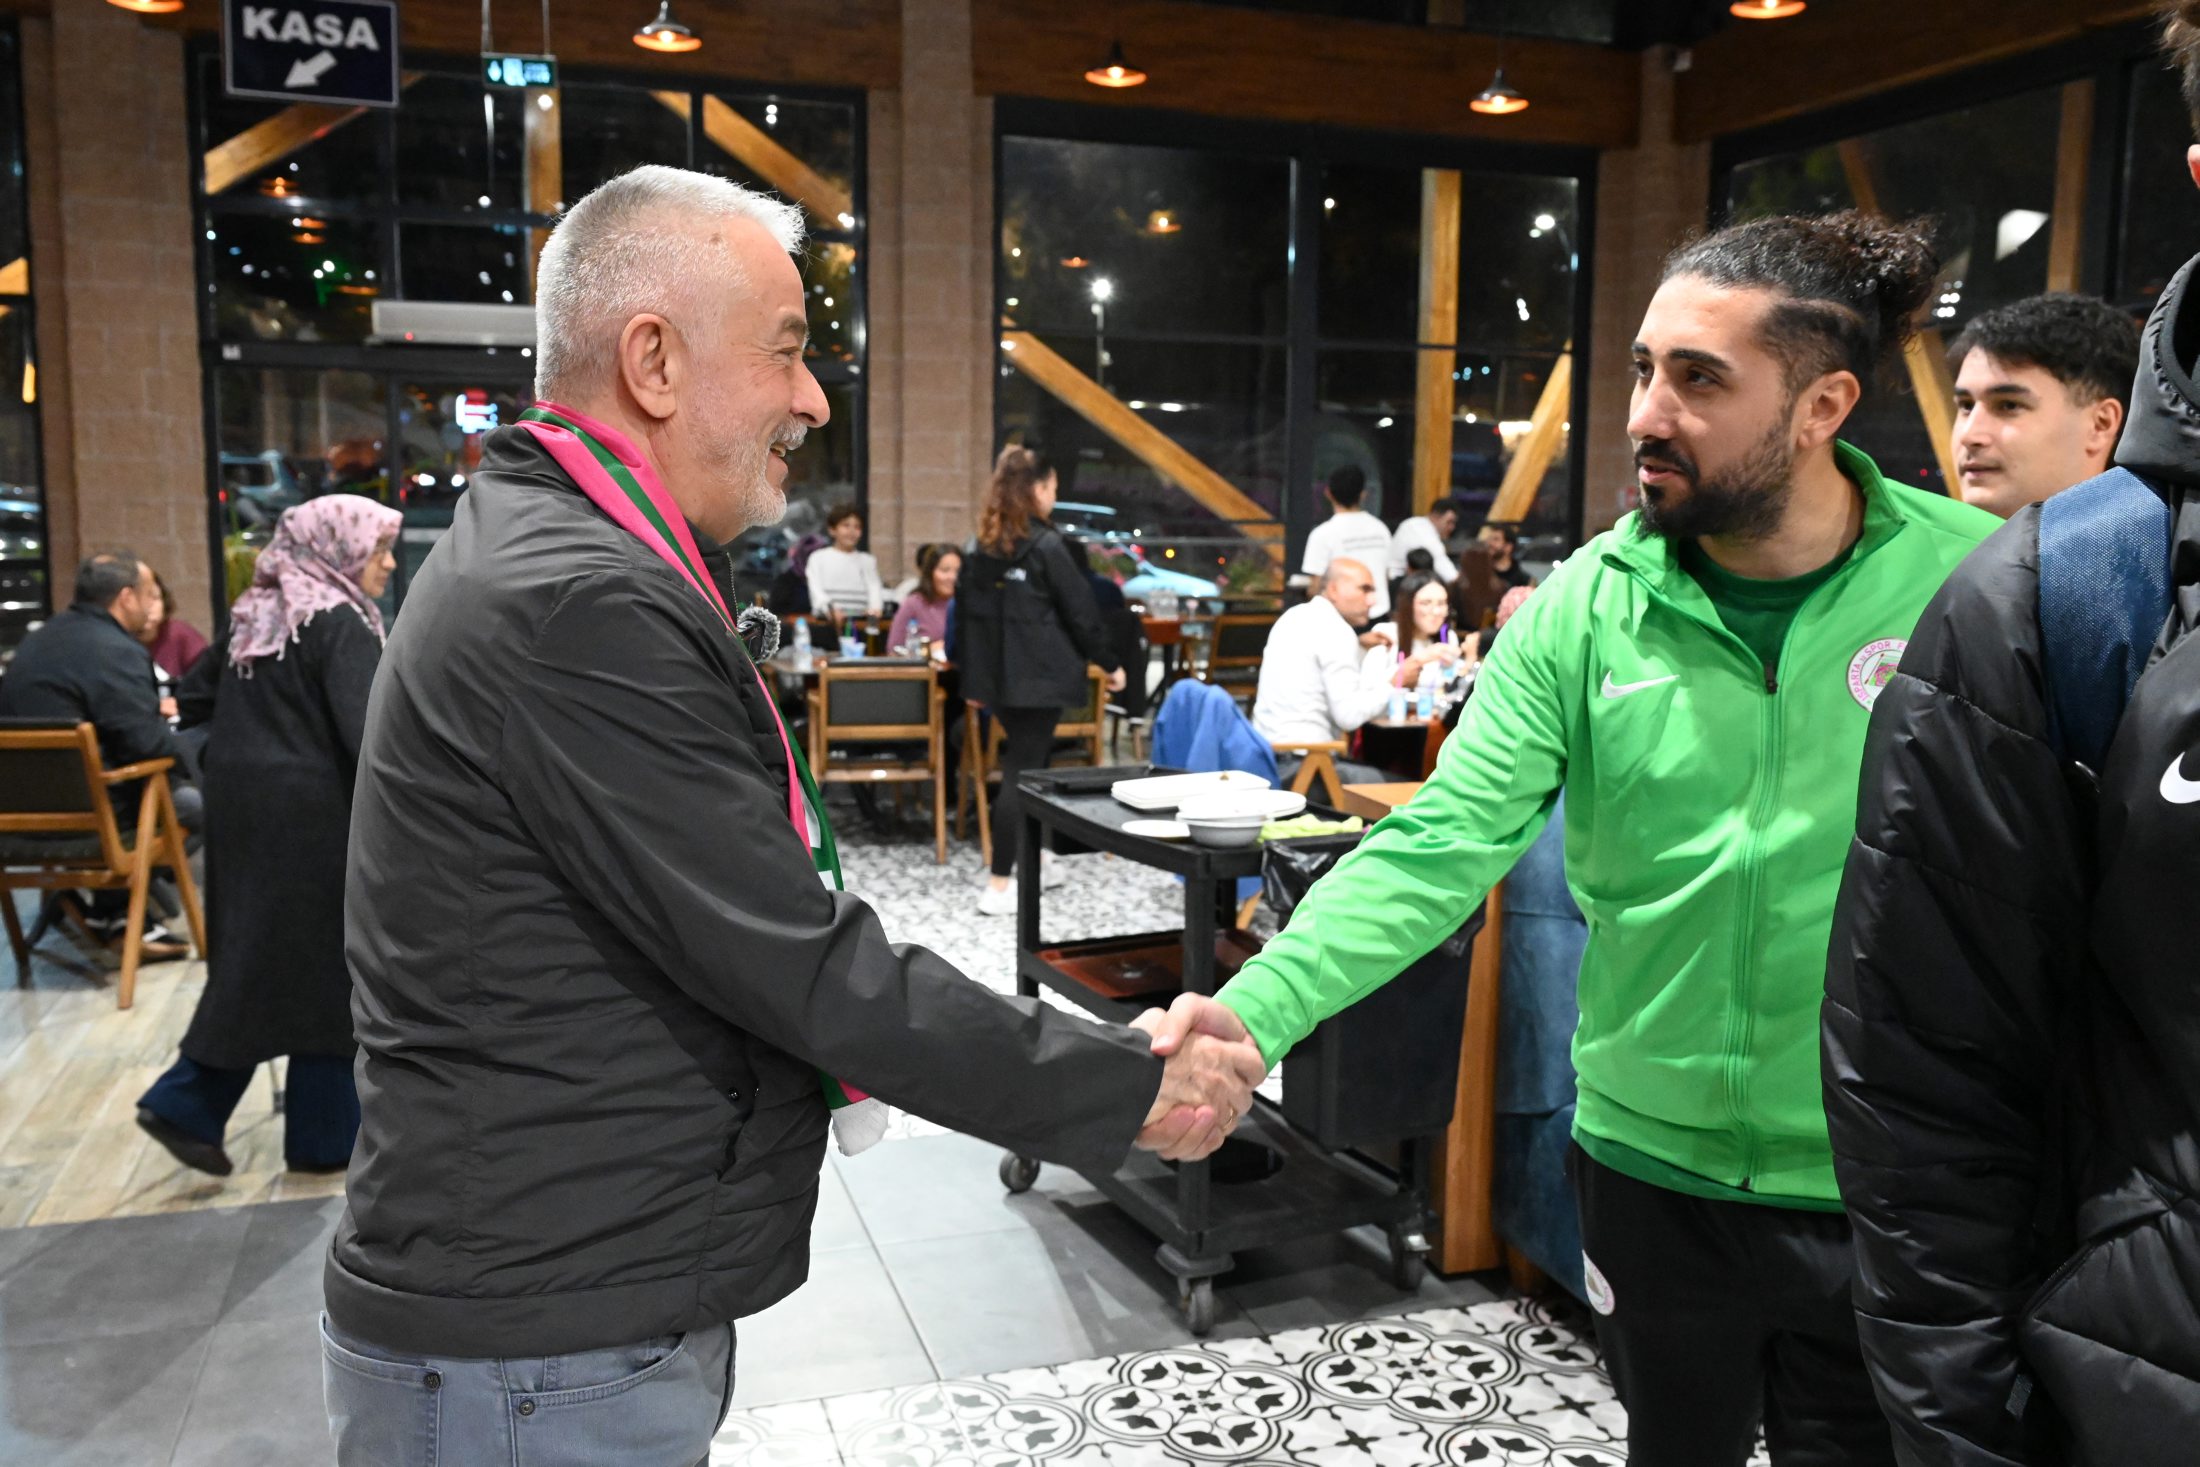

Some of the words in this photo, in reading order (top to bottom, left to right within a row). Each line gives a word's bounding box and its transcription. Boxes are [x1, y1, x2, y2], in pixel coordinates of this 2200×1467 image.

[242, 5, 380, 50] KASA
[1850, 663, 1870, 701] ISPARTA
[1864, 640, 1891, 656] SPOR
